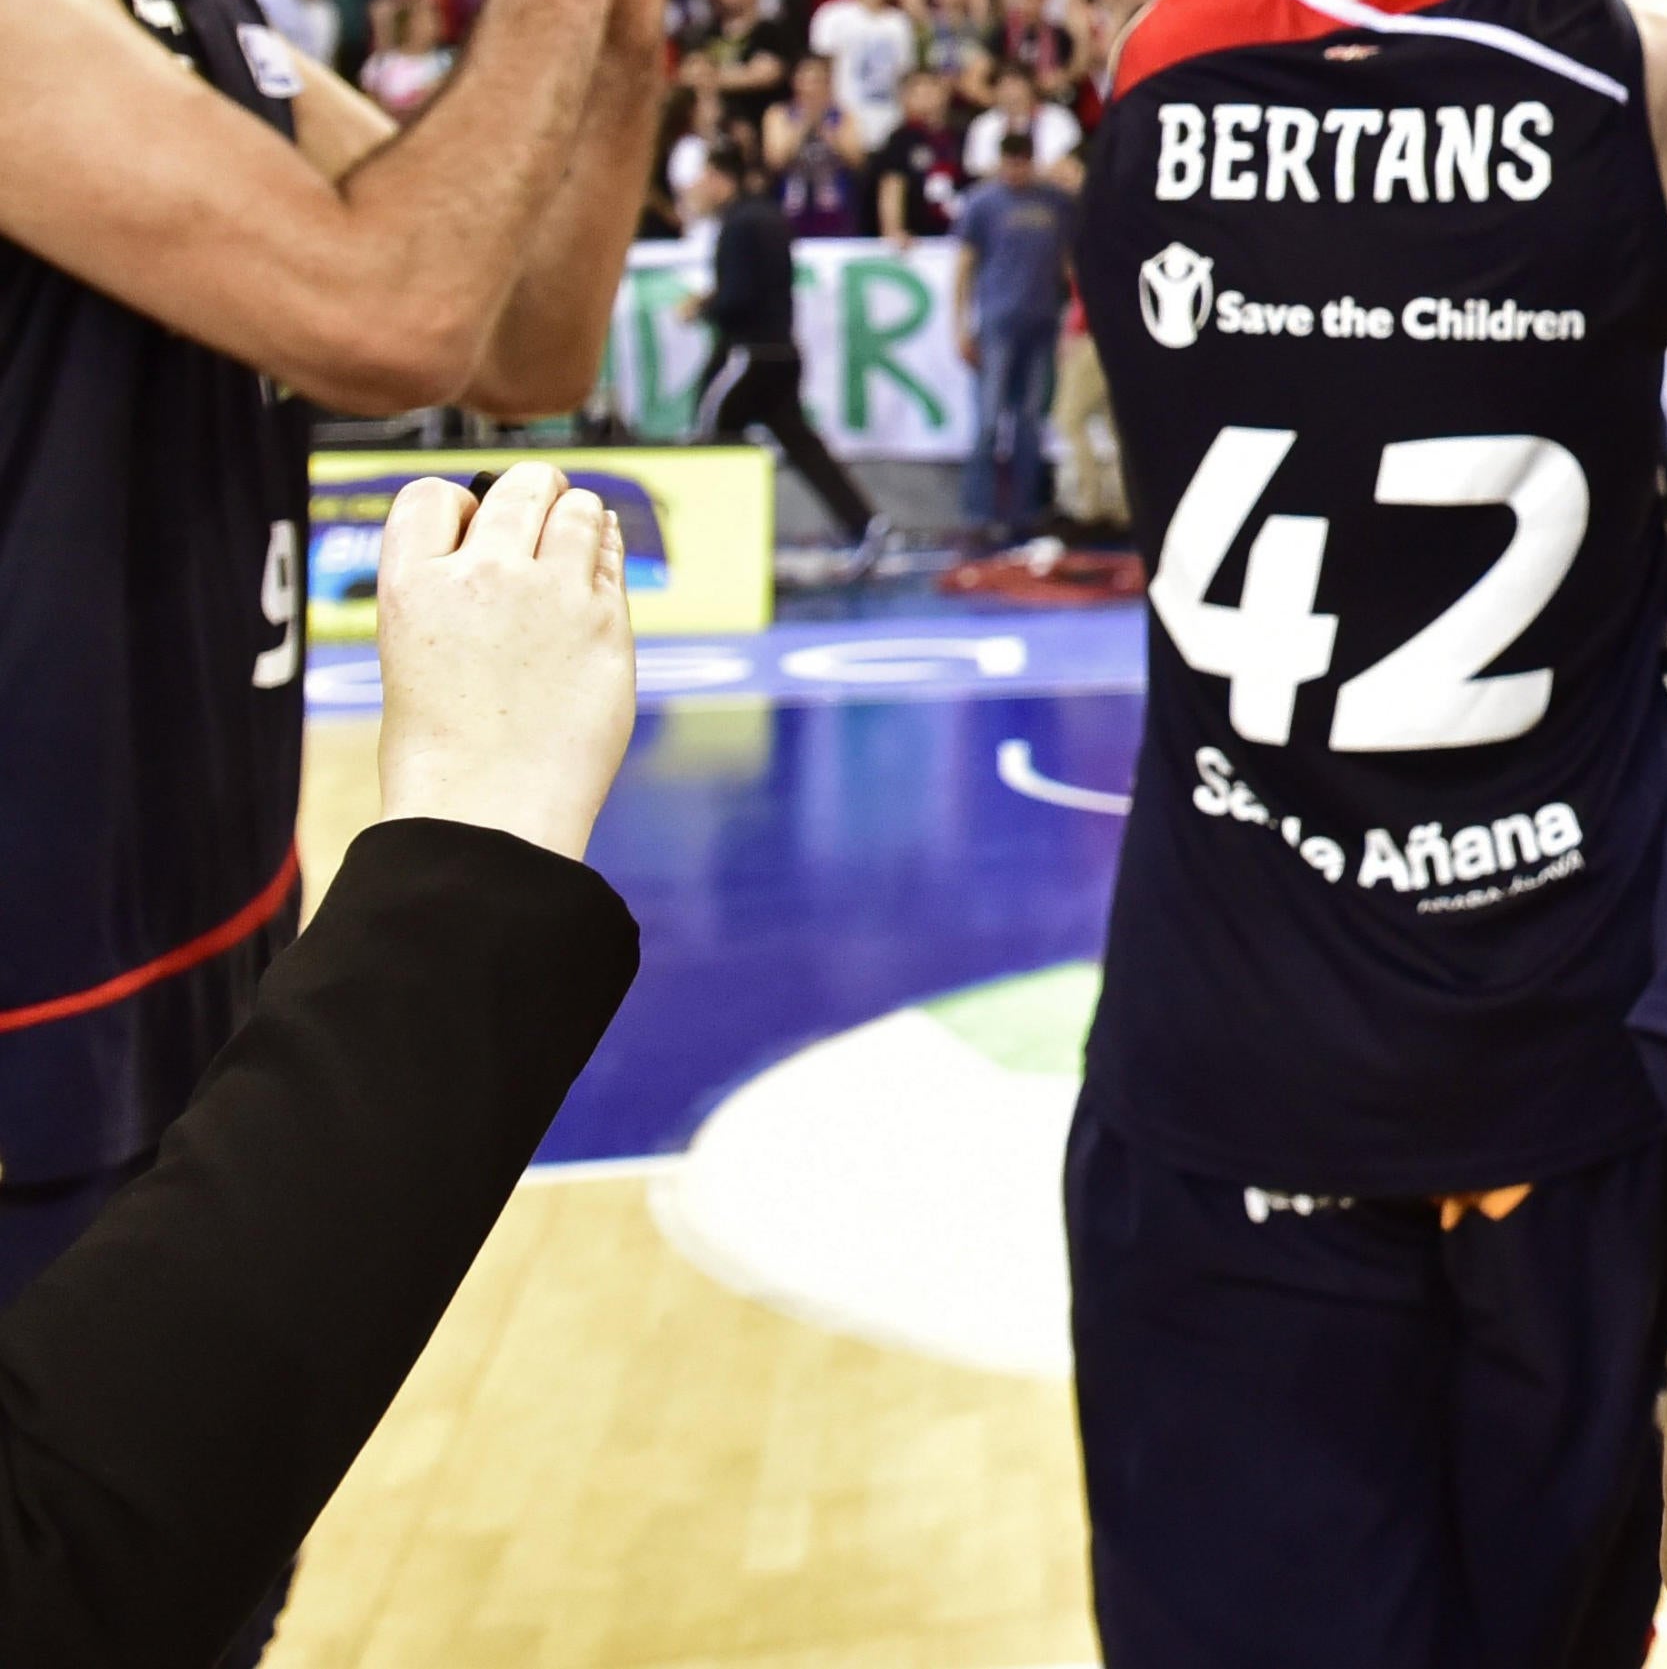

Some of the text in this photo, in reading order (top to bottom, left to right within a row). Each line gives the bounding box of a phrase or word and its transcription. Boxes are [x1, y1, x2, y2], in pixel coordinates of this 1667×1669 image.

[1155, 100, 1554, 203] BERTANS
[1216, 290, 1586, 342] Save the Children
[1148, 425, 1590, 753] 42
[1357, 802, 1583, 893] Añana
